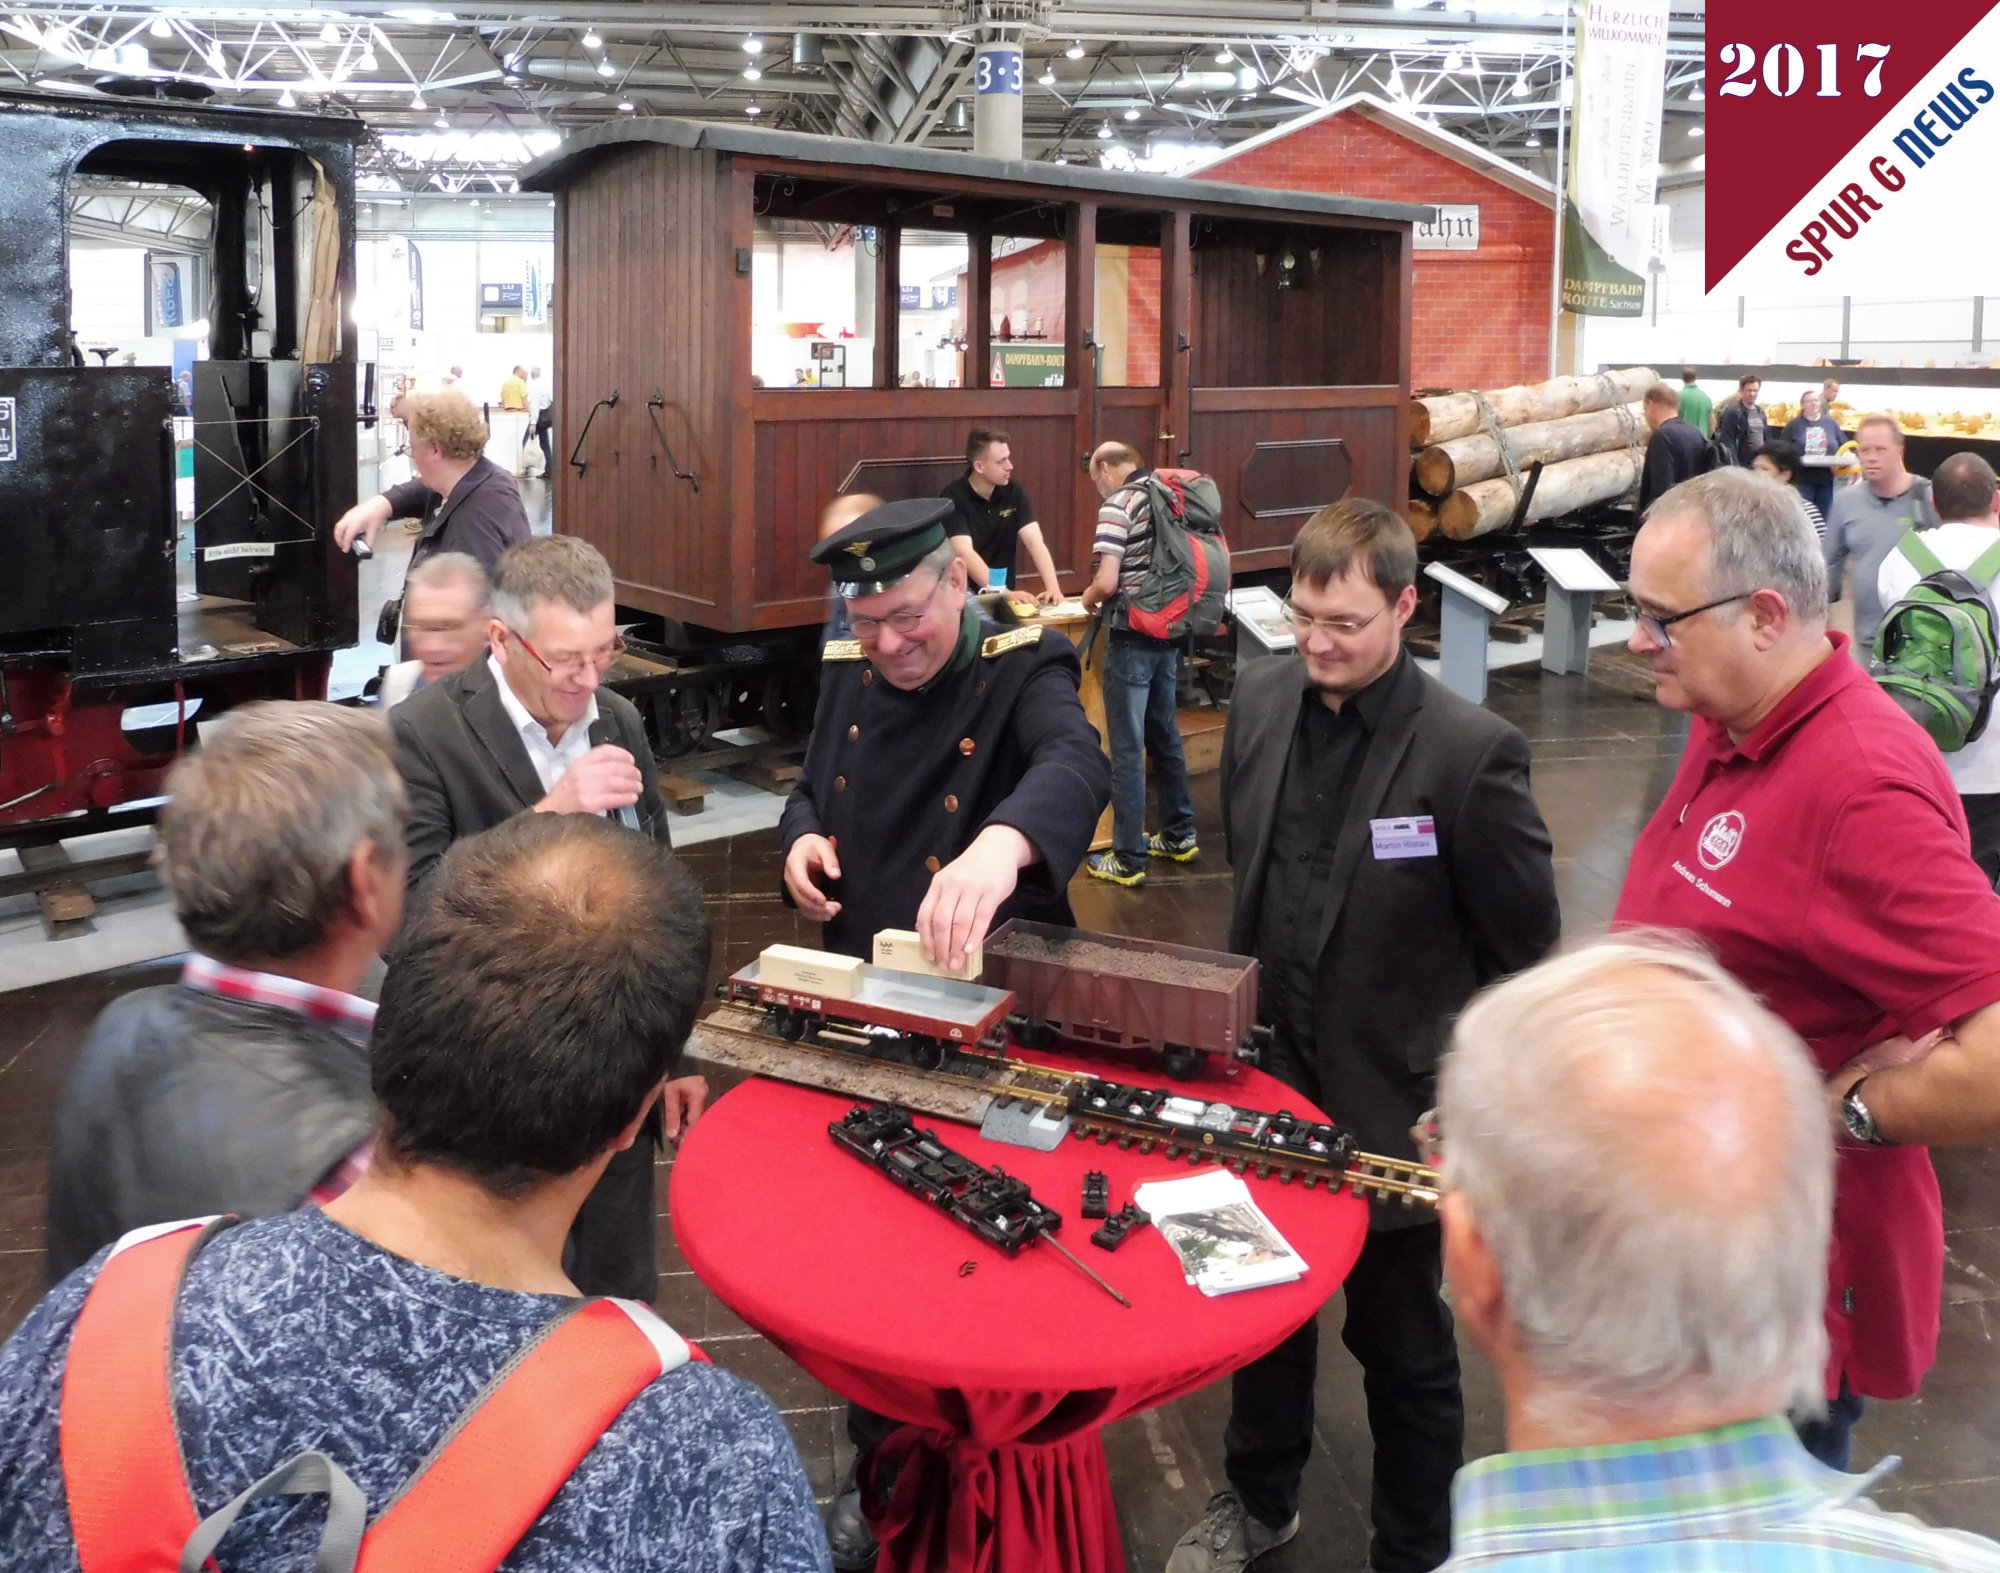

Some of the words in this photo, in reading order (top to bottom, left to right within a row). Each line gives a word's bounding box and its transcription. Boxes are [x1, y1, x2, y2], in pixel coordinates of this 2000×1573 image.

[1589, 4, 1663, 28] HERZLICH
[1588, 27, 1662, 45] WILLKOMMEN
[1564, 278, 1643, 296] DAMPFBAHN
[1562, 292, 1608, 309] ROUTE
[1609, 299, 1641, 310] Sachsen
